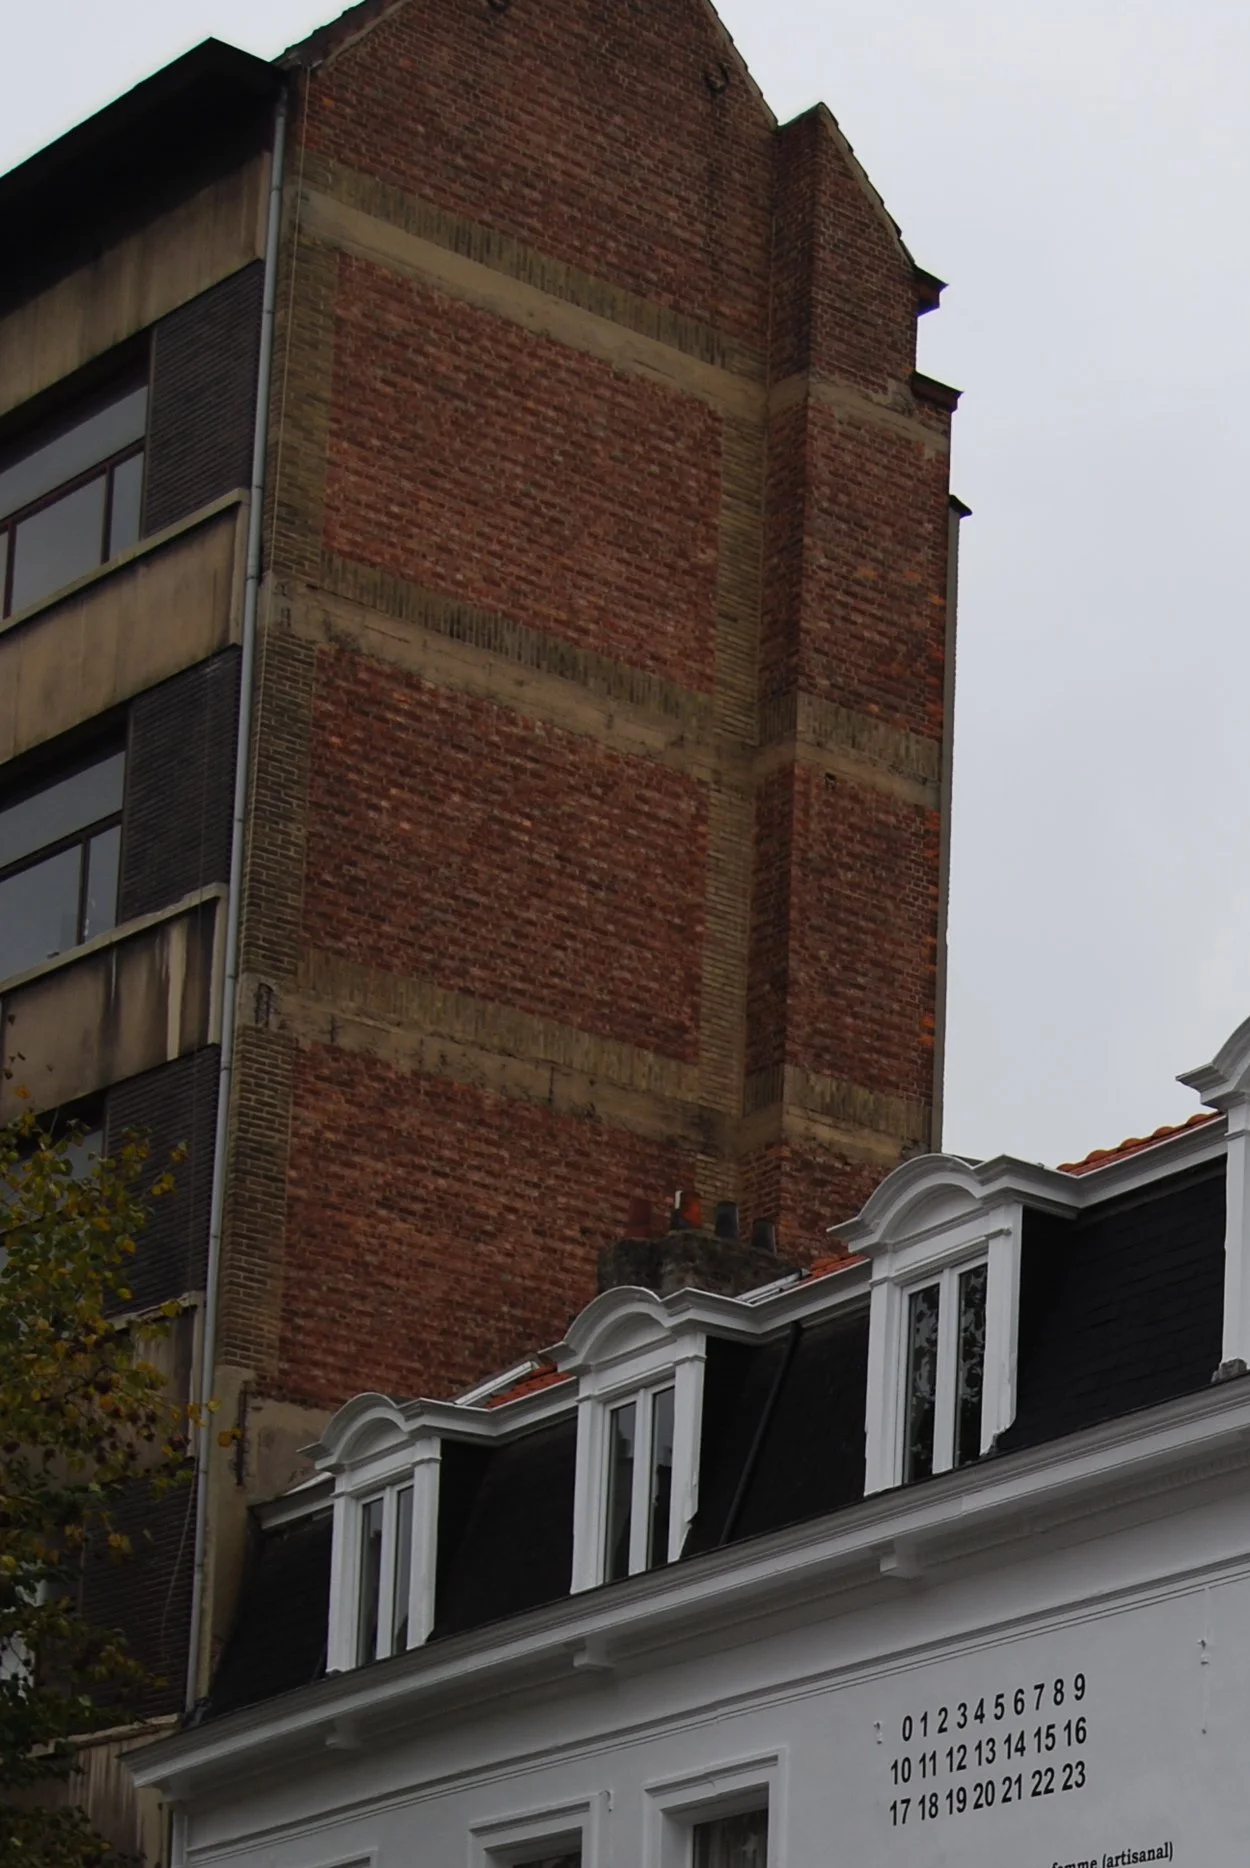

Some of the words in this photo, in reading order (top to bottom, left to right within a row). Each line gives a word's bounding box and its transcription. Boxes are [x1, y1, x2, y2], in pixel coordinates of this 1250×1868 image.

[902, 1715, 913, 1742] 0
[920, 1711, 928, 1737] 1
[937, 1707, 948, 1734] 2
[957, 1702, 967, 1729] 3
[974, 1698, 985, 1724] 4
[994, 1693, 1005, 1720] 5
[1014, 1688, 1025, 1715] 6
[1034, 1683, 1045, 1711] 7
[1053, 1678, 1064, 1706] 8
[1074, 1673, 1085, 1701] 9
[891, 1757, 911, 1785] 10
[919, 1750, 936, 1779] 11
[946, 1744, 967, 1773] 12
[975, 1737, 996, 1766] 13
[1004, 1730, 1026, 1760] 14
[1034, 1724, 1056, 1753] 15
[1064, 1716, 1087, 1747] 16
[890, 1798, 911, 1826] 17
[918, 1792, 938, 1821] 18
[946, 1786, 967, 1815] 19
[973, 1780, 995, 1810] 20
[1001, 1773, 1022, 1804] 21
[1031, 1767, 1055, 1797] 22
[1062, 1760, 1085, 1791] 23
